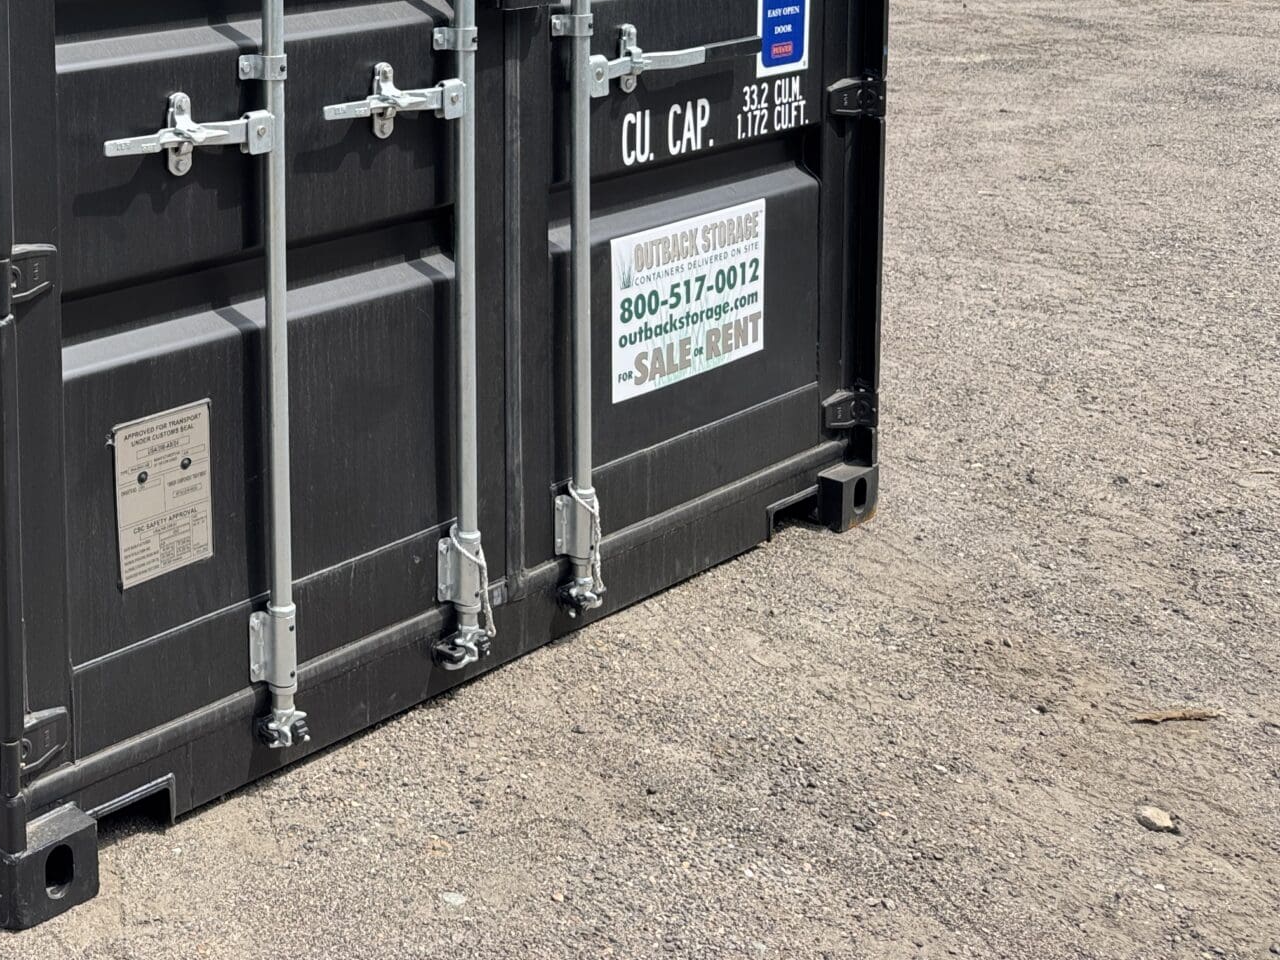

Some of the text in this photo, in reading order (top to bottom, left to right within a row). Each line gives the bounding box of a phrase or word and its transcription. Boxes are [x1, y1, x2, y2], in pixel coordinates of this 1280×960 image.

[767, 5, 800, 18] EASY OPEN
[774, 23, 793, 35] DOOR
[742, 75, 803, 113] 33.2 CU.M.
[622, 109, 655, 166] CU.
[668, 97, 715, 156] CAP.
[774, 100, 810, 132] CU.FT.
[634, 211, 760, 273] OUTBACK STORAGE
[634, 242, 760, 287] CONTAINERS DELIVERED ON SITE
[619, 257, 760, 324] 800-517-0012
[619, 291, 758, 348] outbackstorage.com
[618, 311, 762, 386] FOR SALE OR RENT
[124, 412, 202, 441] APPROVED FOR TRANSPORT
[131, 436, 151, 447] UNDER
[152, 428, 179, 440] CUSTOMS
[146, 517, 167, 530] SAFETY
[169, 507, 198, 521] APPROVAL
